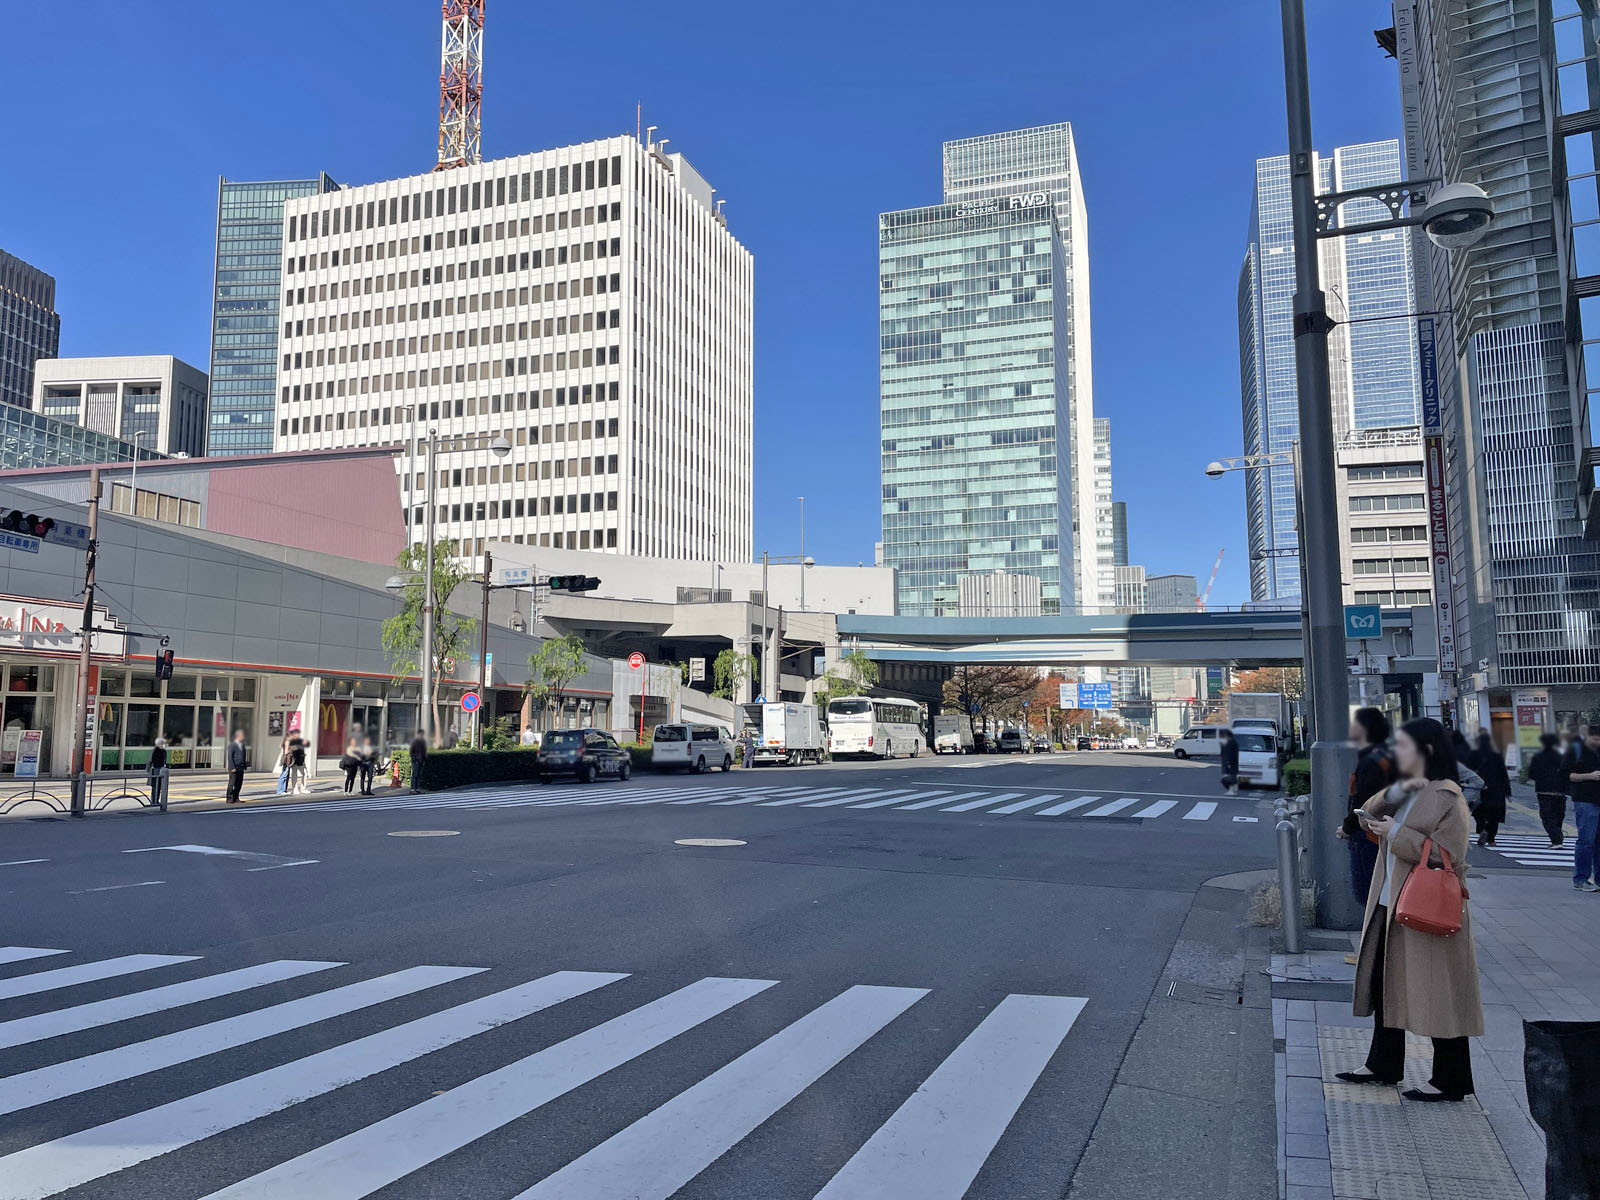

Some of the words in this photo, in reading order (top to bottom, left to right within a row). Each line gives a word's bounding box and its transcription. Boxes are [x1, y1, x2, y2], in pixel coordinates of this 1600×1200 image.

[1405, 106, 1418, 171] Bellissima
[962, 199, 995, 209] PACIFIC
[1009, 192, 1047, 210] FWD
[1420, 320, 1438, 426] 銀座フェミークリニック
[1431, 489, 1448, 553] まるごと高知
